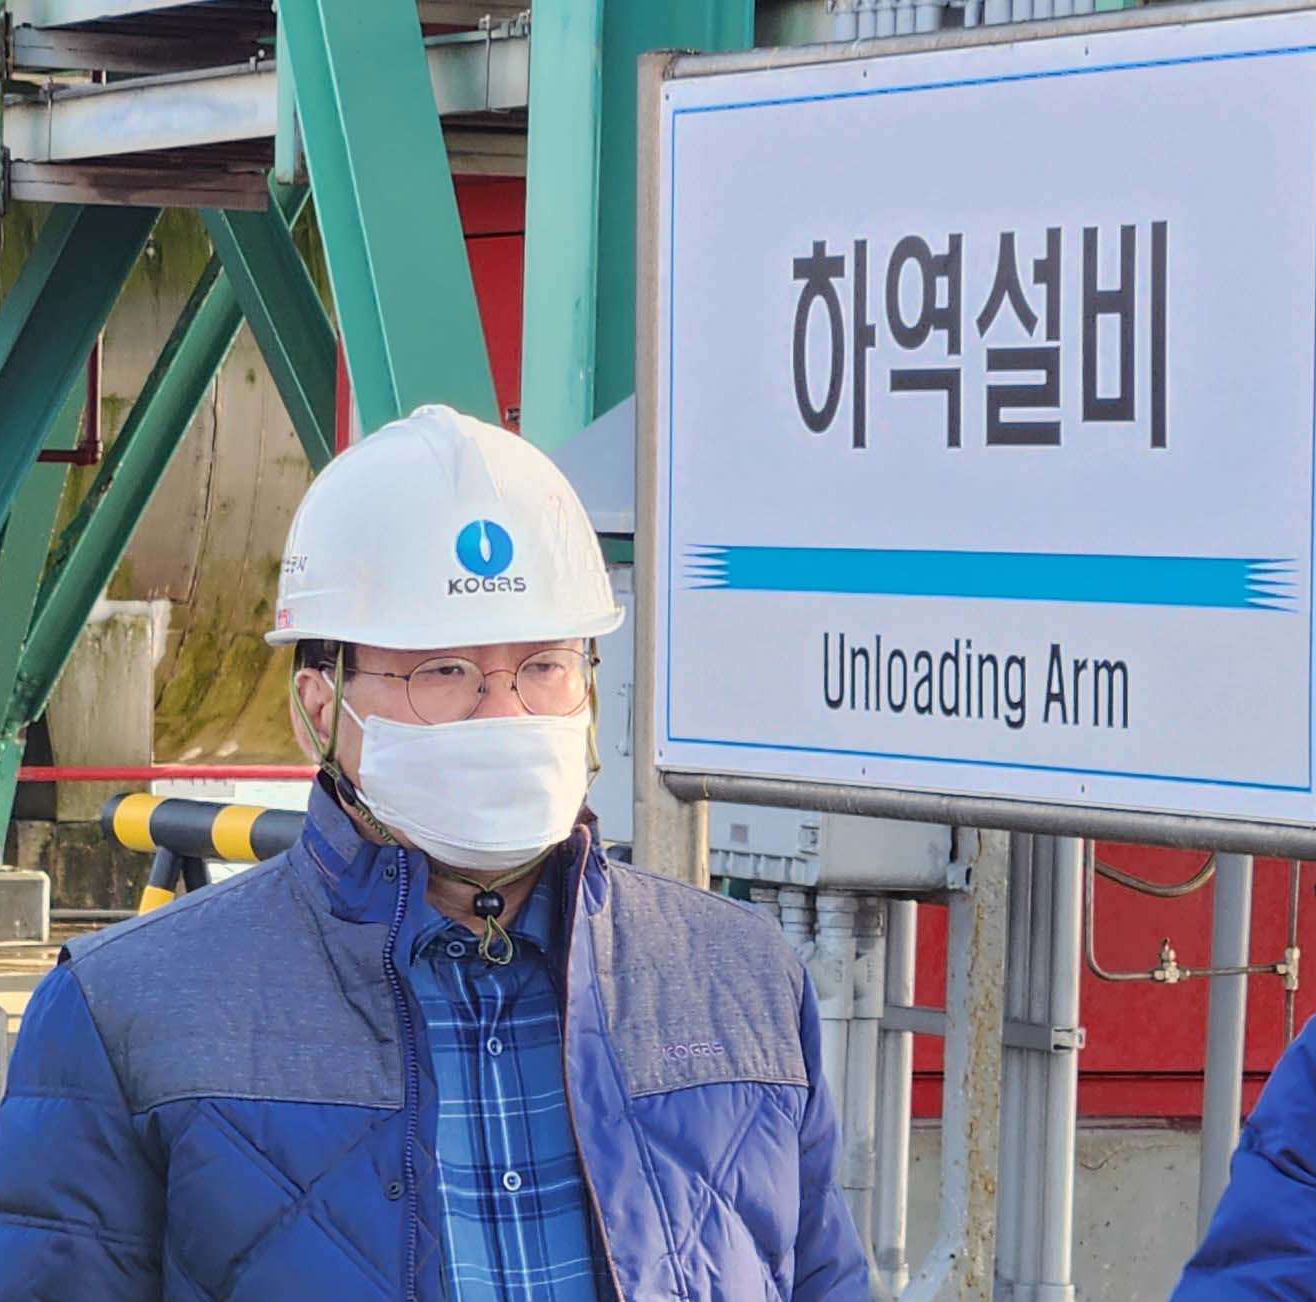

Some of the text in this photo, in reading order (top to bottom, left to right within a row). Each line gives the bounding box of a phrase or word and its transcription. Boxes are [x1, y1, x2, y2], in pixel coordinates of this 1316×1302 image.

[791, 219, 1169, 450] 하역설비
[822, 632, 1130, 730] Unloading Arm
